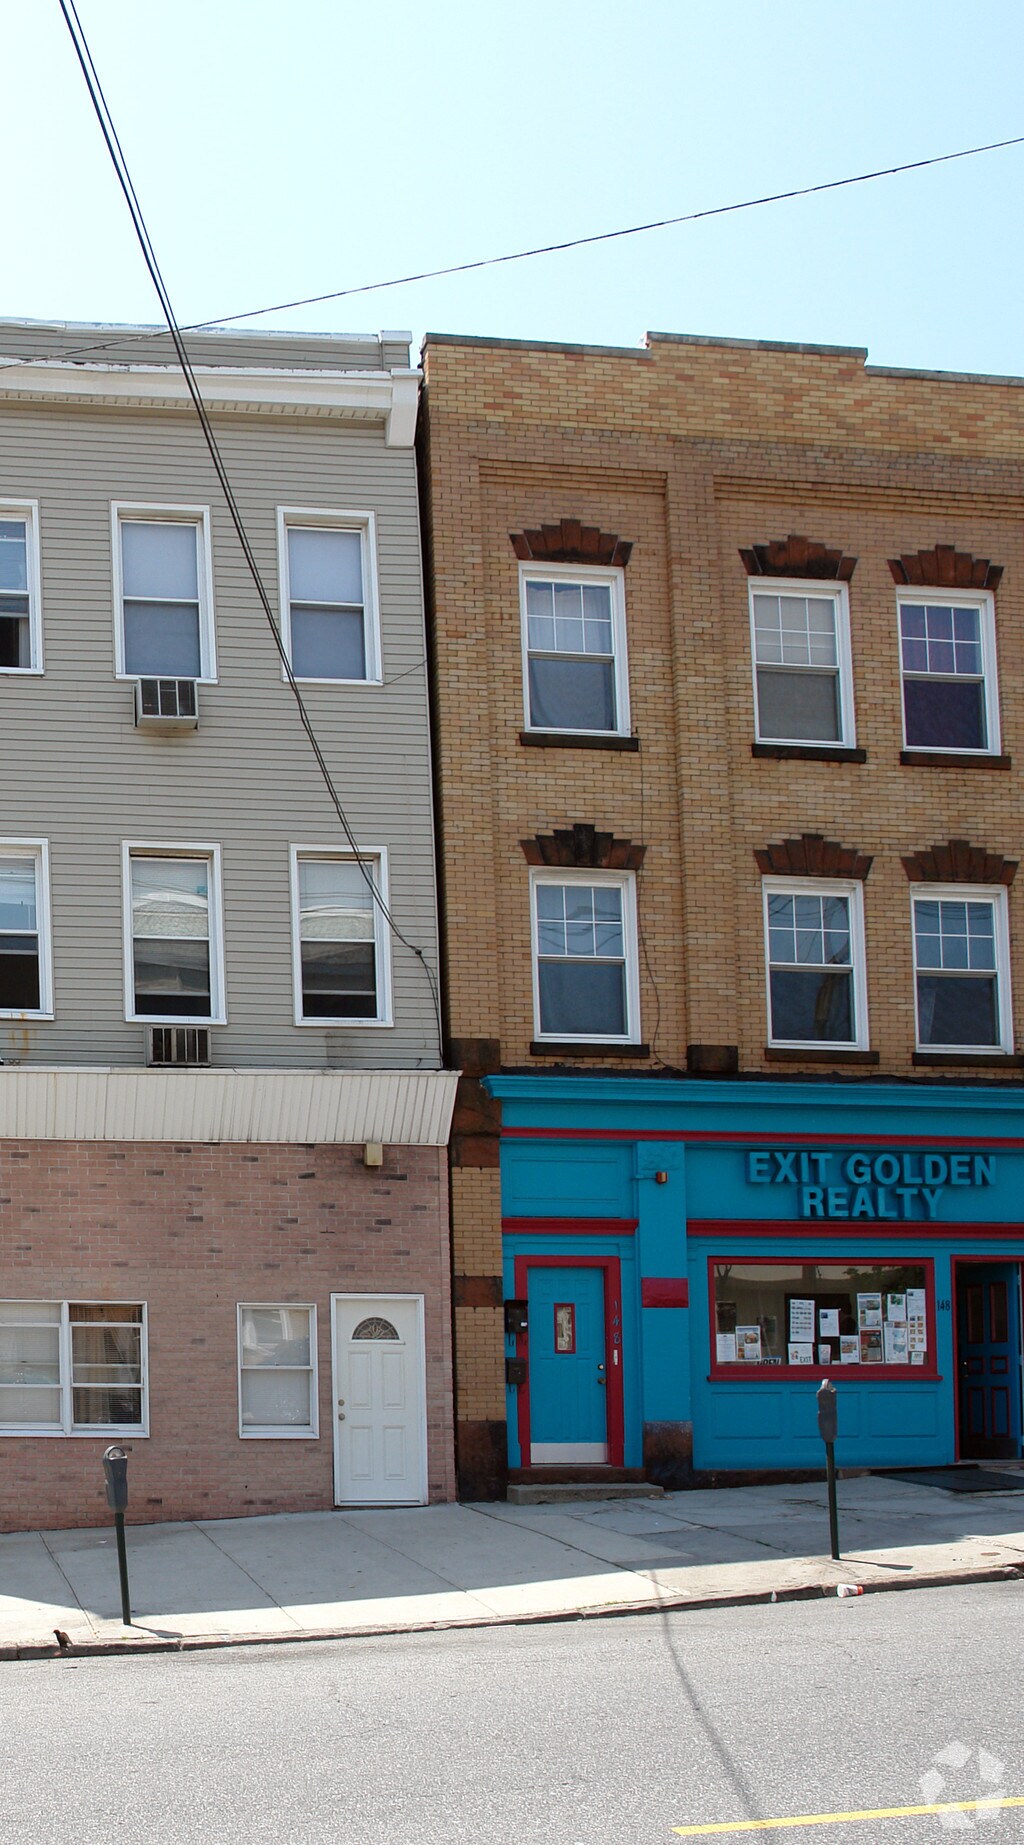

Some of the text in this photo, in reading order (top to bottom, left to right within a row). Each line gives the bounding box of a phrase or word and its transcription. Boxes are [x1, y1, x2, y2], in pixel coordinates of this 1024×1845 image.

[748, 1152, 997, 1186] EXIT GOLDEN
[802, 1187, 943, 1218] REALTY
[937, 1300, 951, 1311] 148
